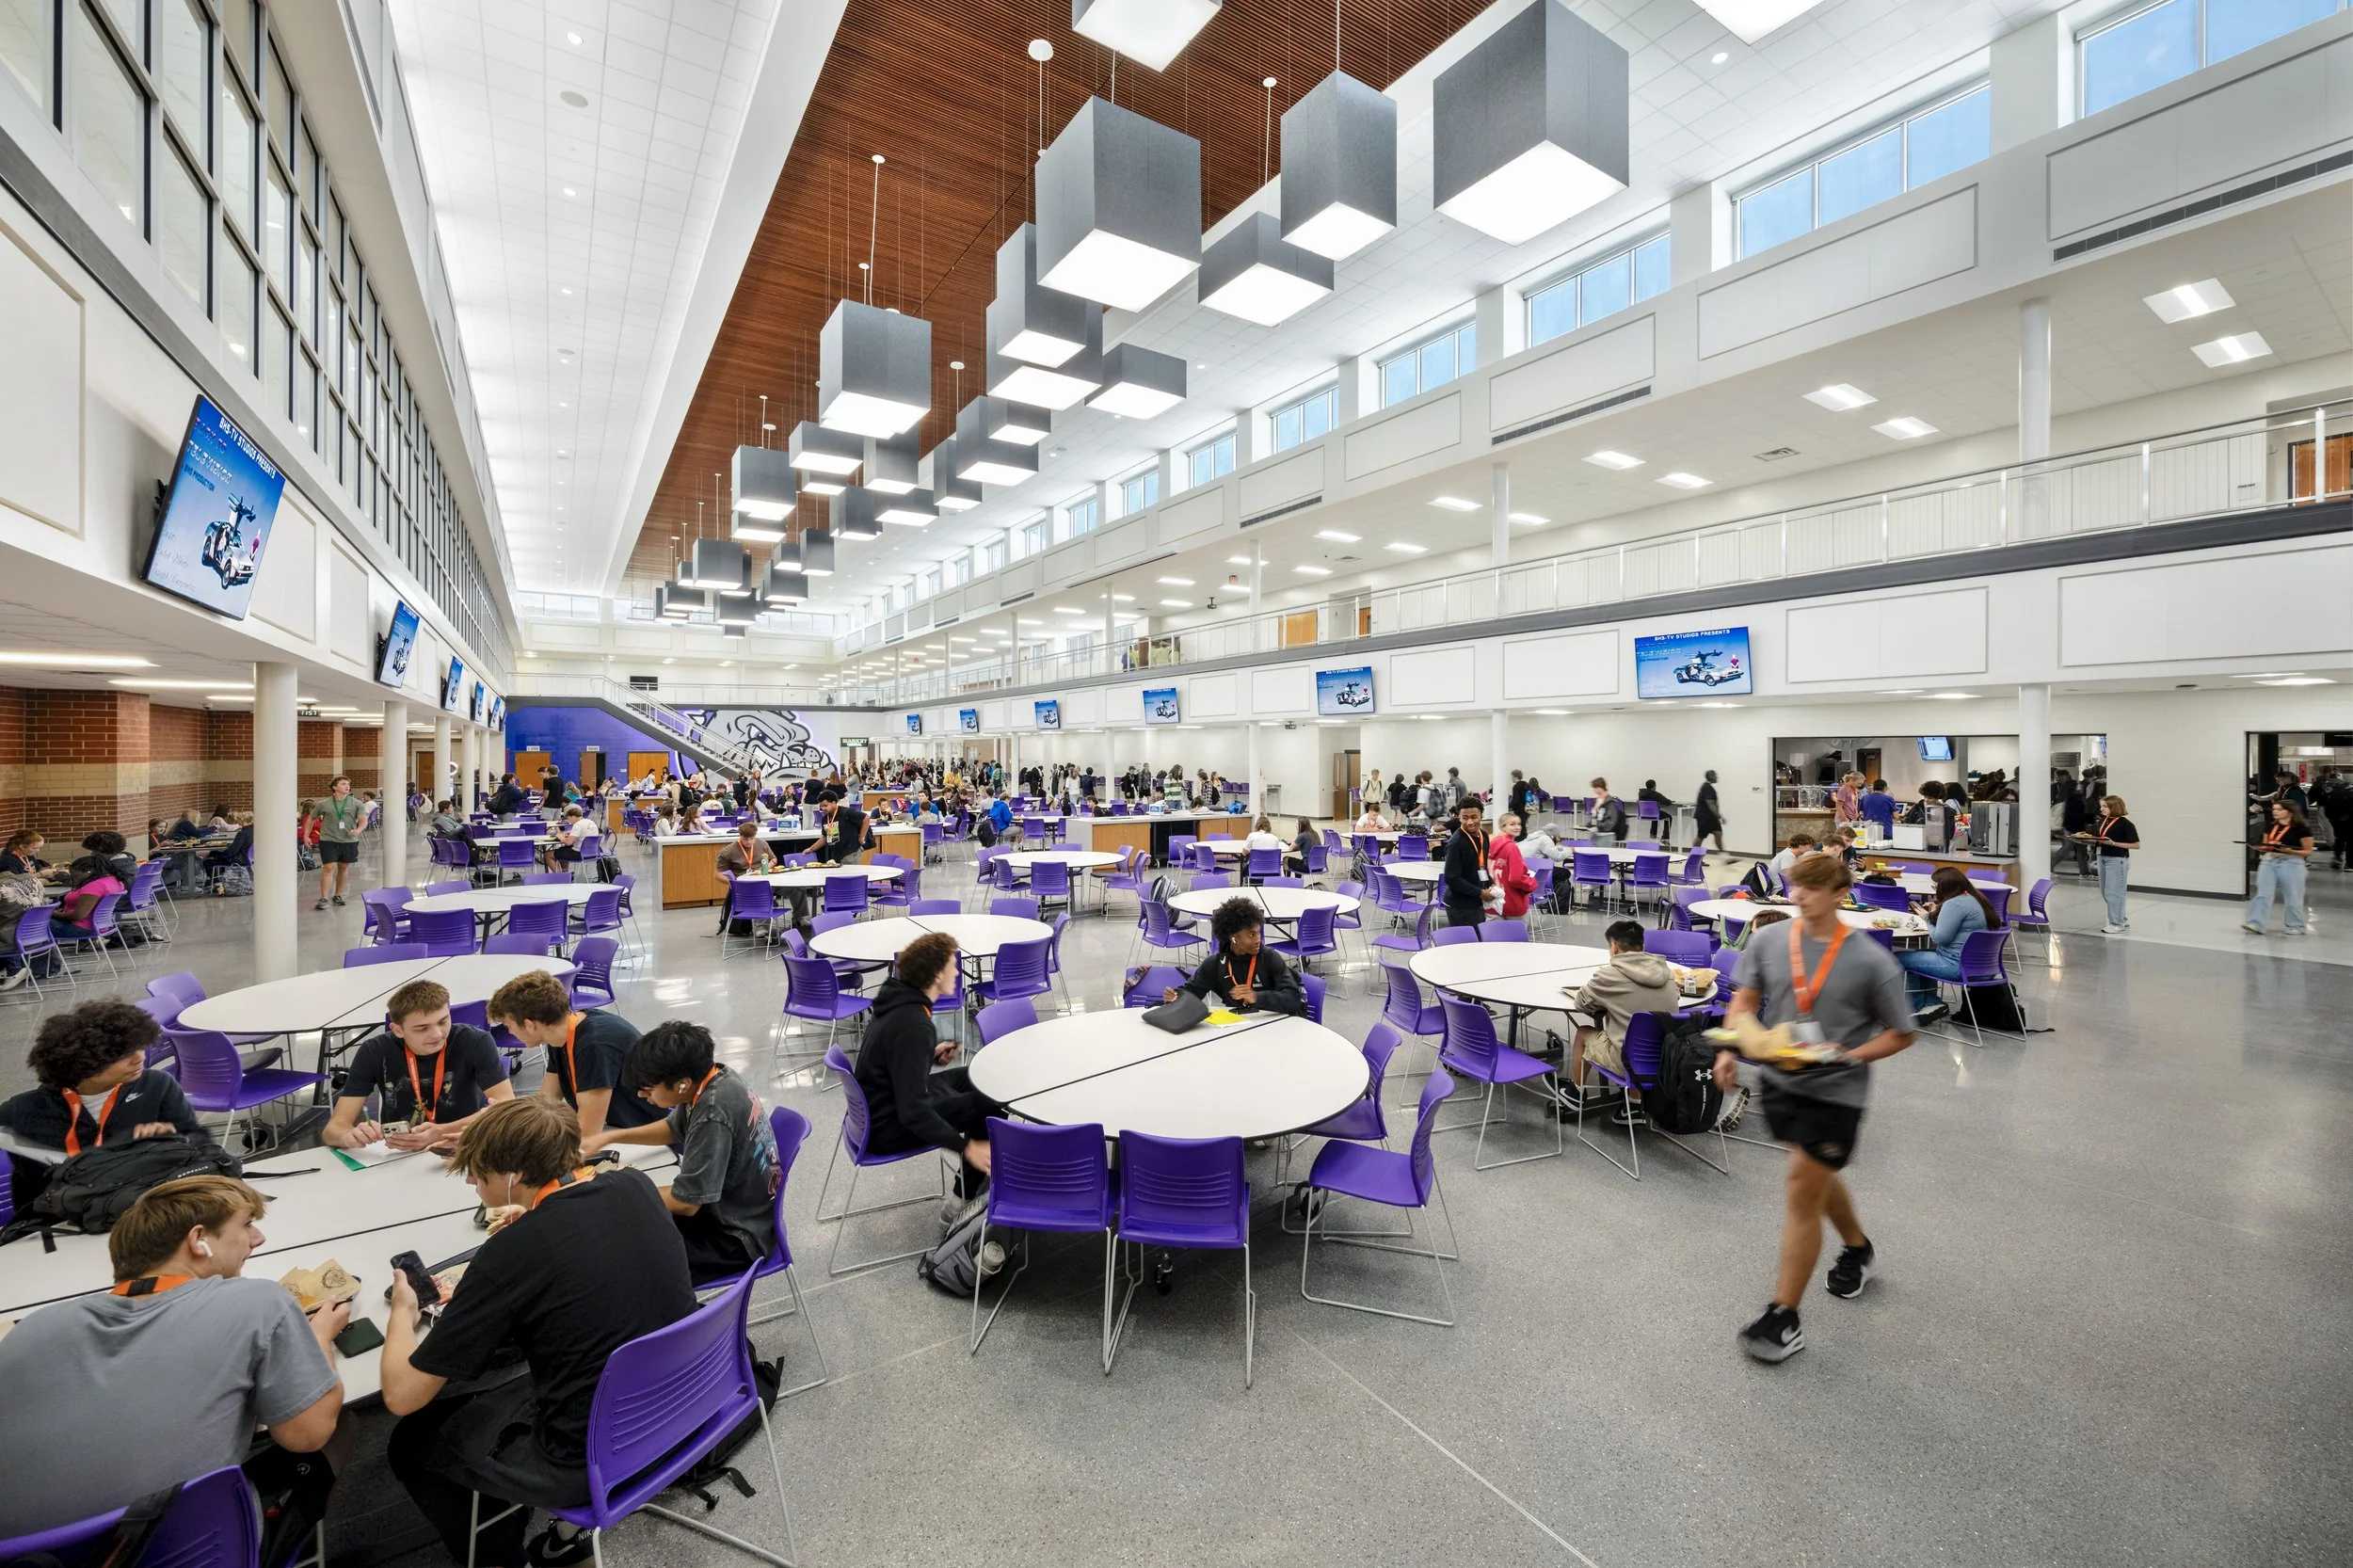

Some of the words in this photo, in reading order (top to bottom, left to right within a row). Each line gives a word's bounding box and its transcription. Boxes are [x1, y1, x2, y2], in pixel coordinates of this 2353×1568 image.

[187, 440, 232, 484] TELEVISION
[219, 417, 239, 441] BHS-TV
[237, 439, 257, 462] STUDIOS
[254, 452, 276, 479] PRESENTS
